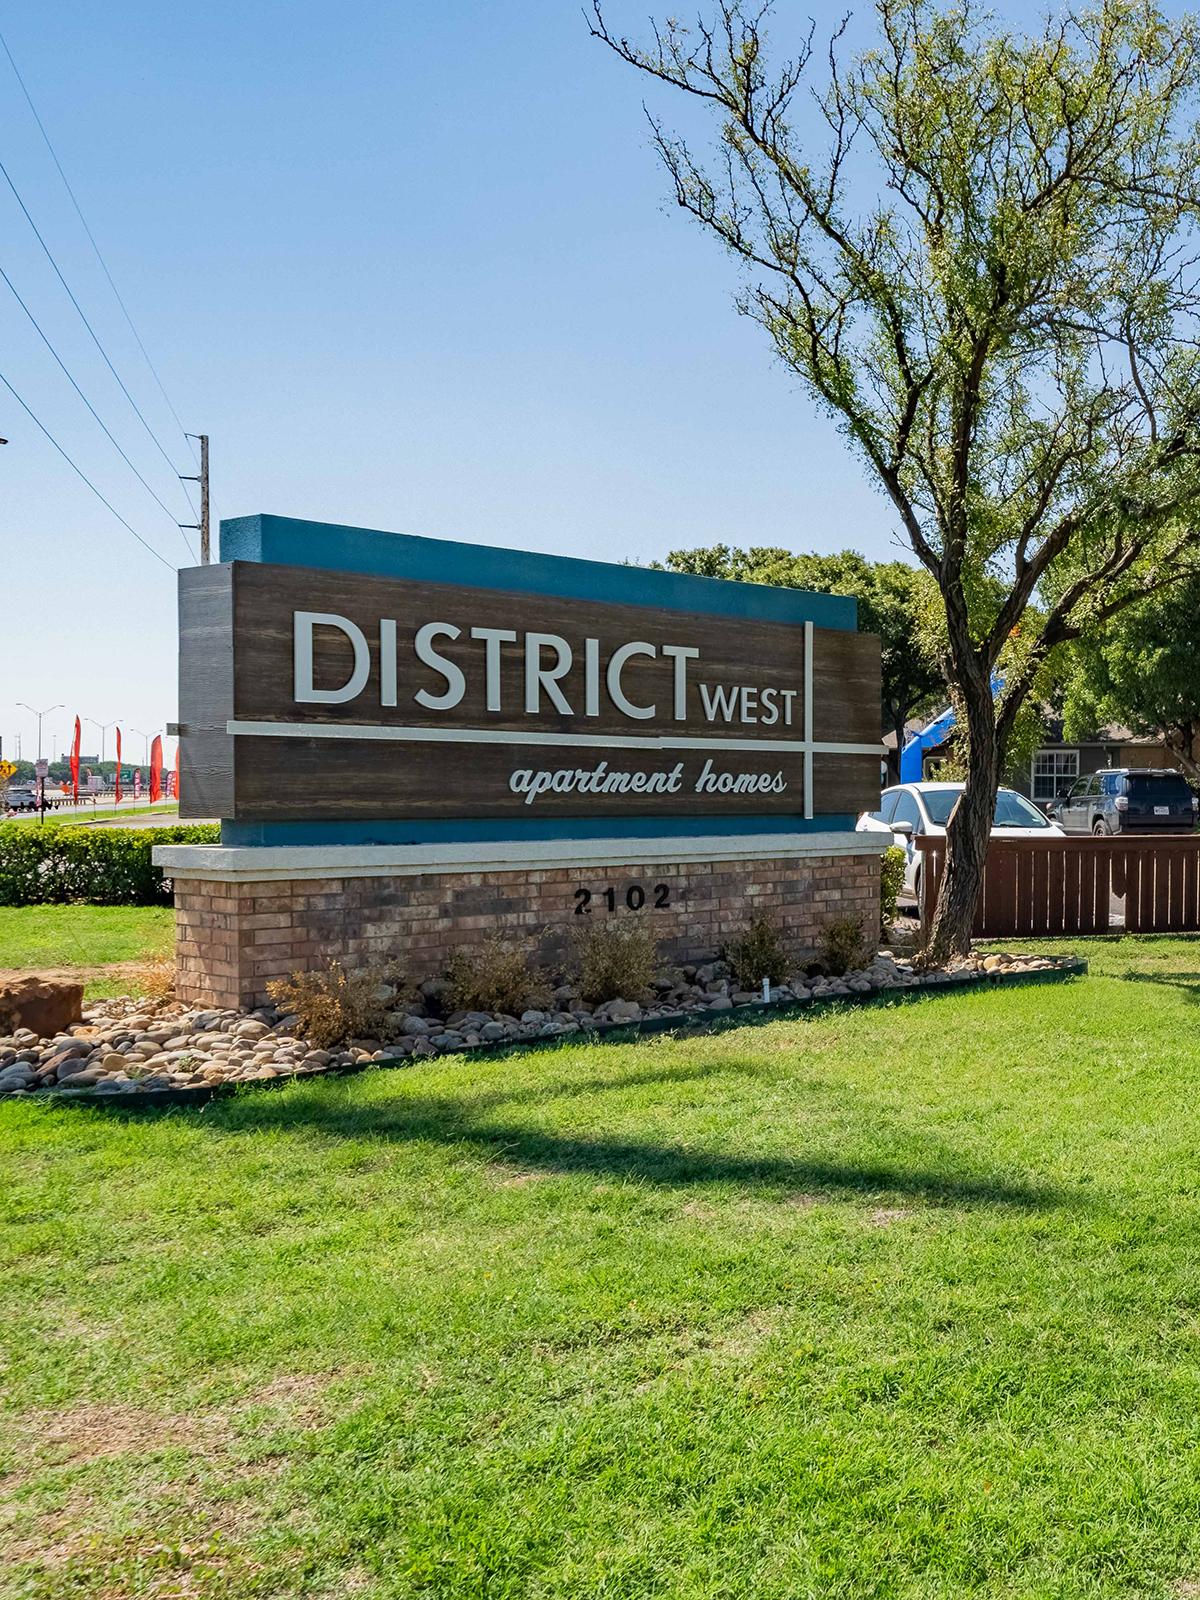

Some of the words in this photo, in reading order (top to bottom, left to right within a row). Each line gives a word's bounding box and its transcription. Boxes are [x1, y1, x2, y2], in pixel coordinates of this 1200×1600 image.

[293, 611, 700, 721] DISTRICT
[700, 684, 798, 725] WEST
[509, 761, 684, 804] apartment
[695, 759, 787, 793] homes
[574, 884, 670, 914] 2102
